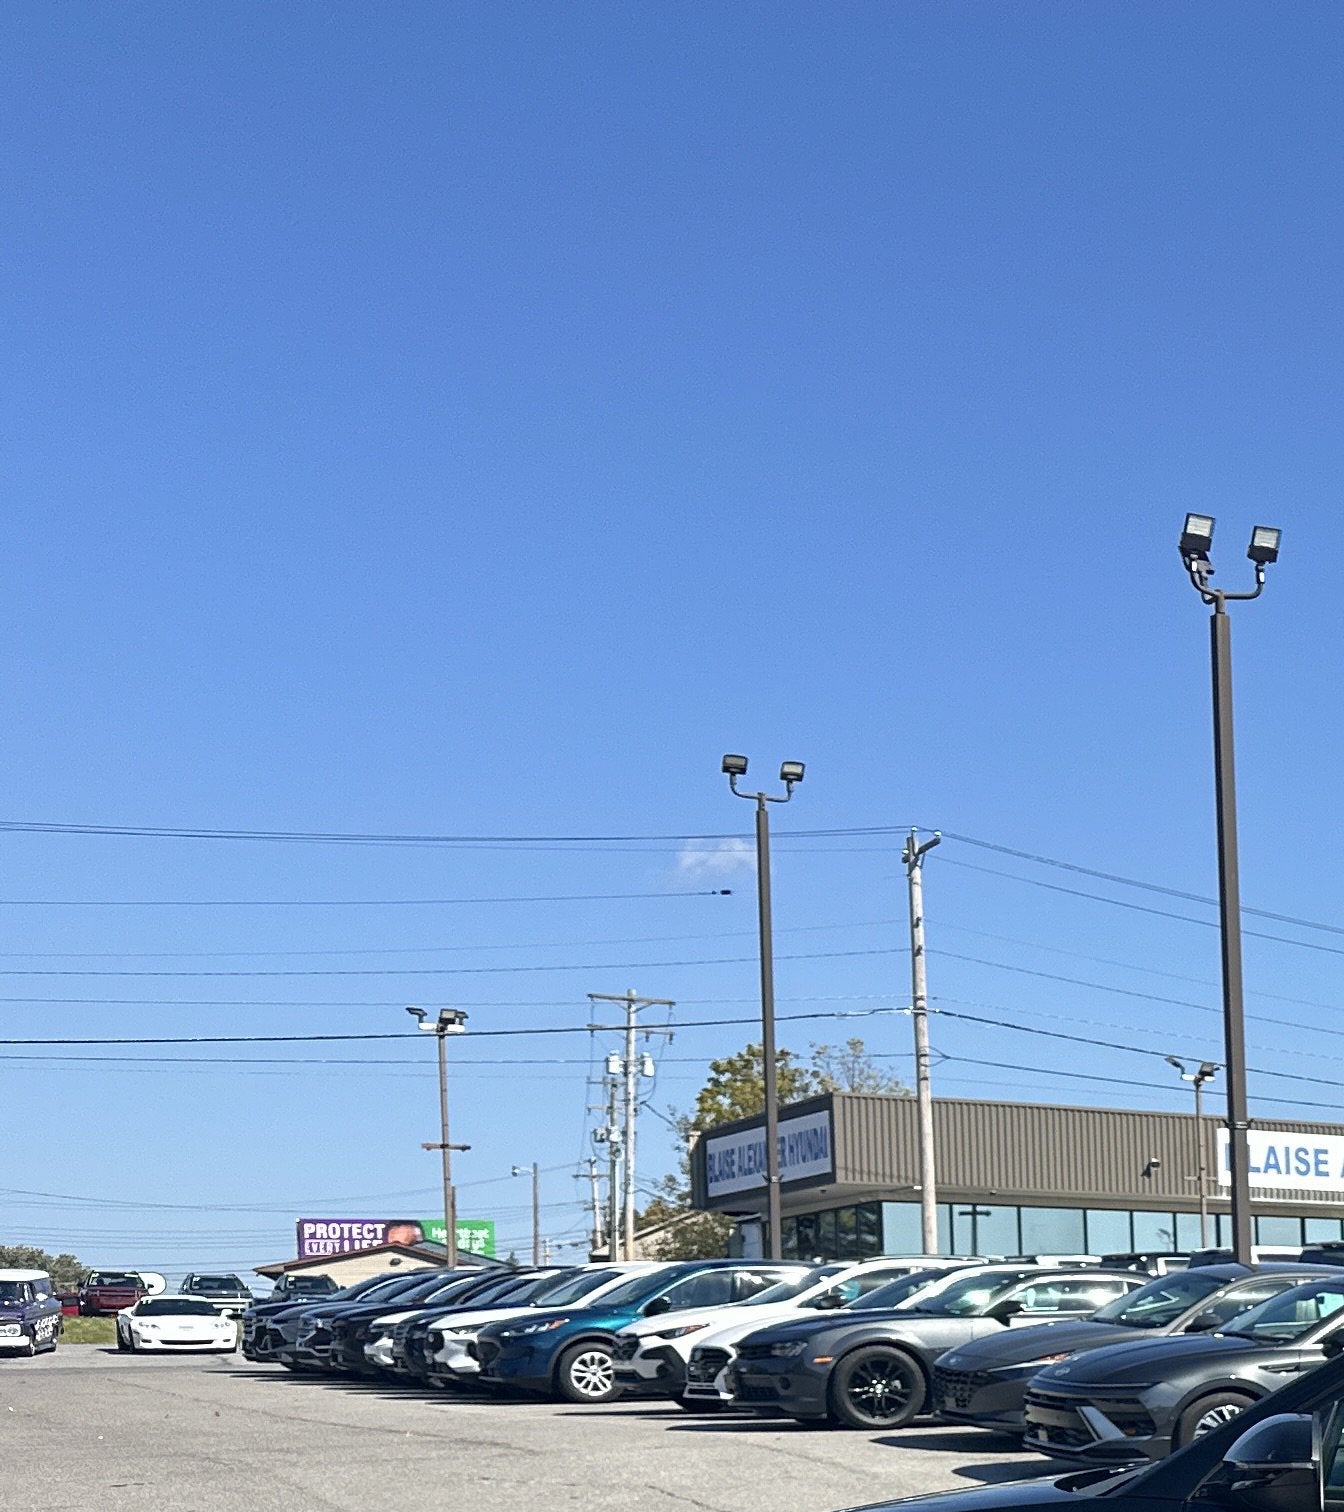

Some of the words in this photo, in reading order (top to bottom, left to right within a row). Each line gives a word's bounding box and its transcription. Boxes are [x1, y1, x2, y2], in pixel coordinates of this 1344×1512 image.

[708, 1148, 736, 1184] BLAISE
[738, 1136, 788, 1178] ALEXAER
[788, 1125, 829, 1167] HYUNDAI
[1225, 1143, 1329, 1177] LAISE
[303, 1223, 386, 1239] PROTECT
[304, 1240, 340, 1255] EVERY
